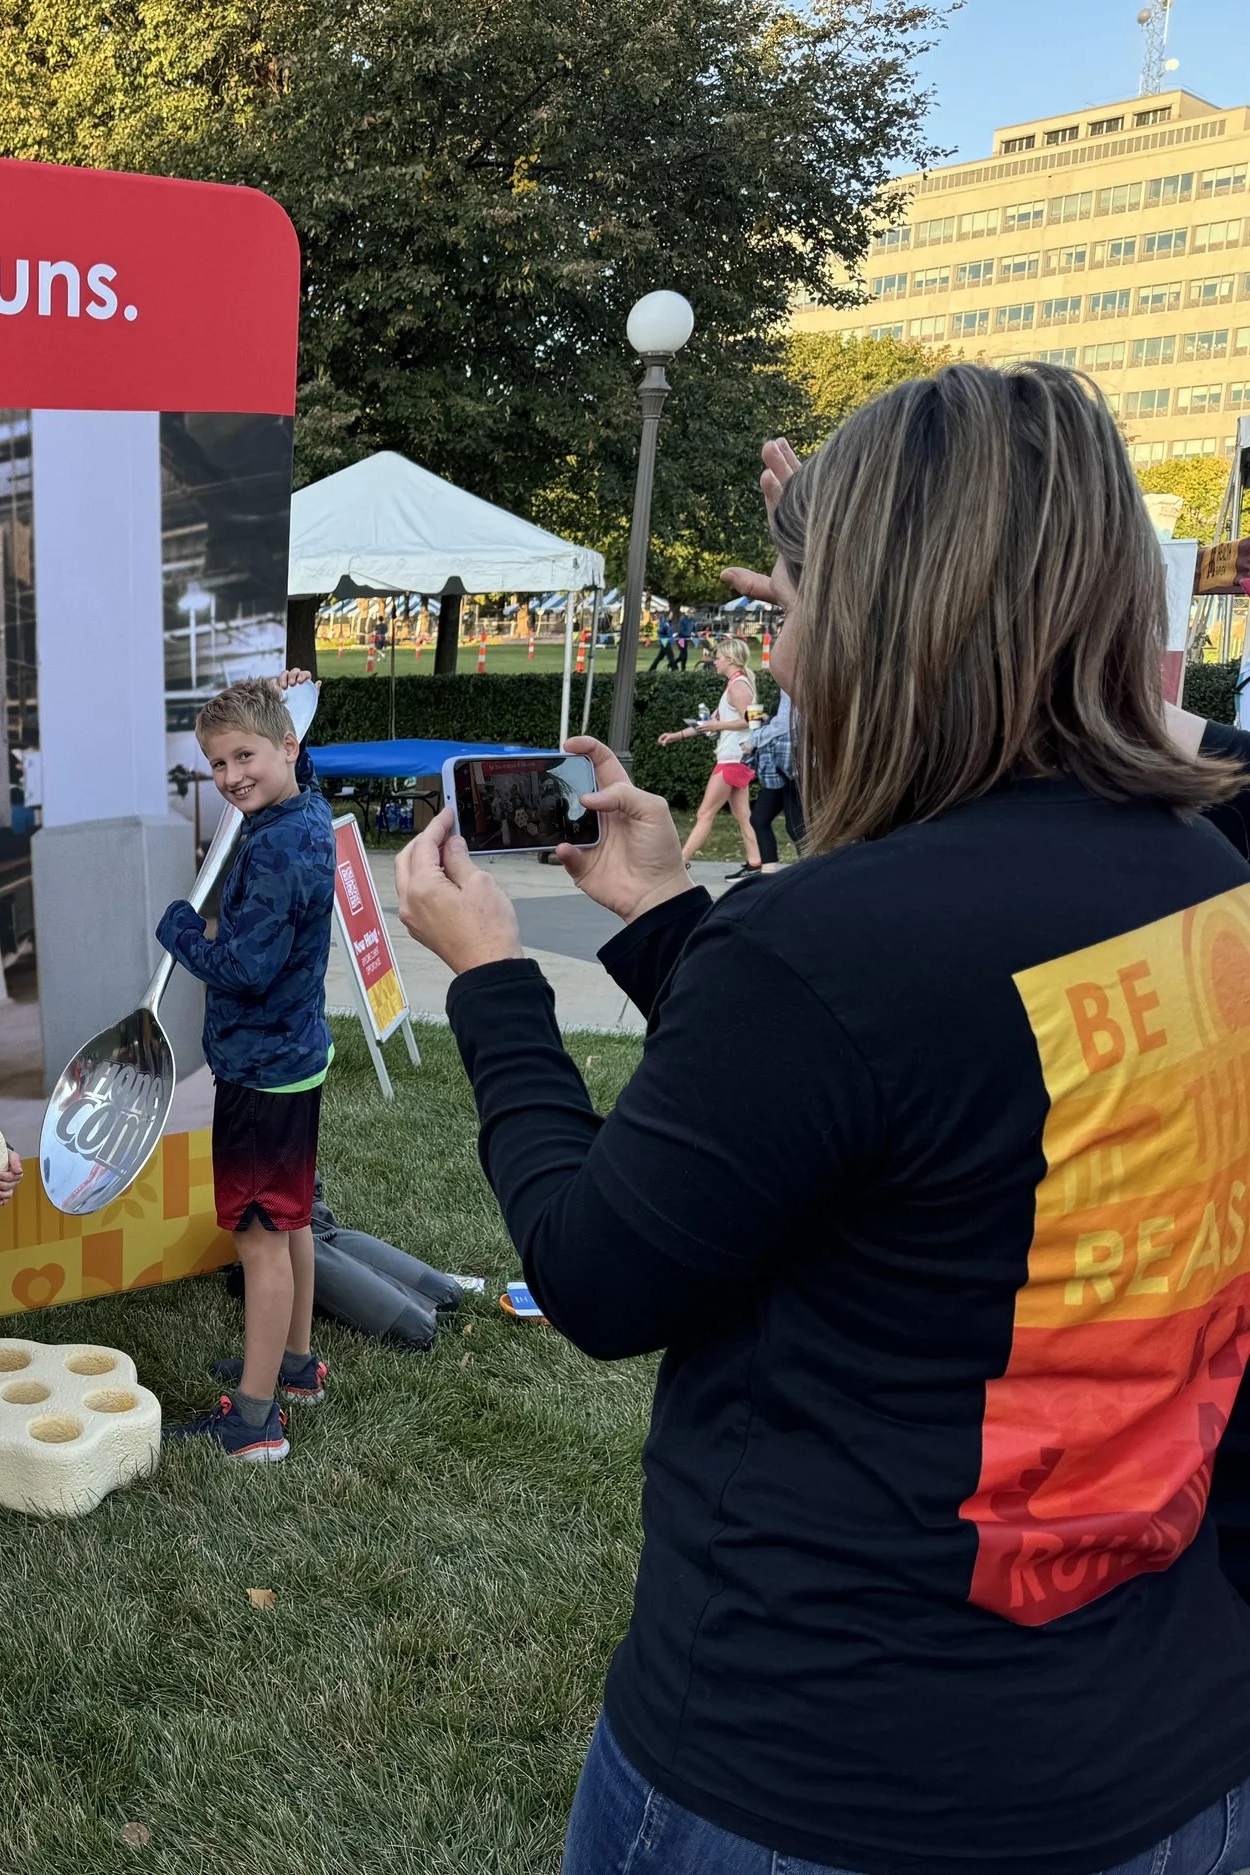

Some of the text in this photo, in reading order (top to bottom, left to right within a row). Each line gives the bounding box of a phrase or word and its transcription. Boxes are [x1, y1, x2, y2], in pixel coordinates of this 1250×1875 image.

[1065, 958, 1168, 1076] BE
[1184, 1054, 1250, 1166] TH
[1063, 1178, 1250, 1306] REAS
